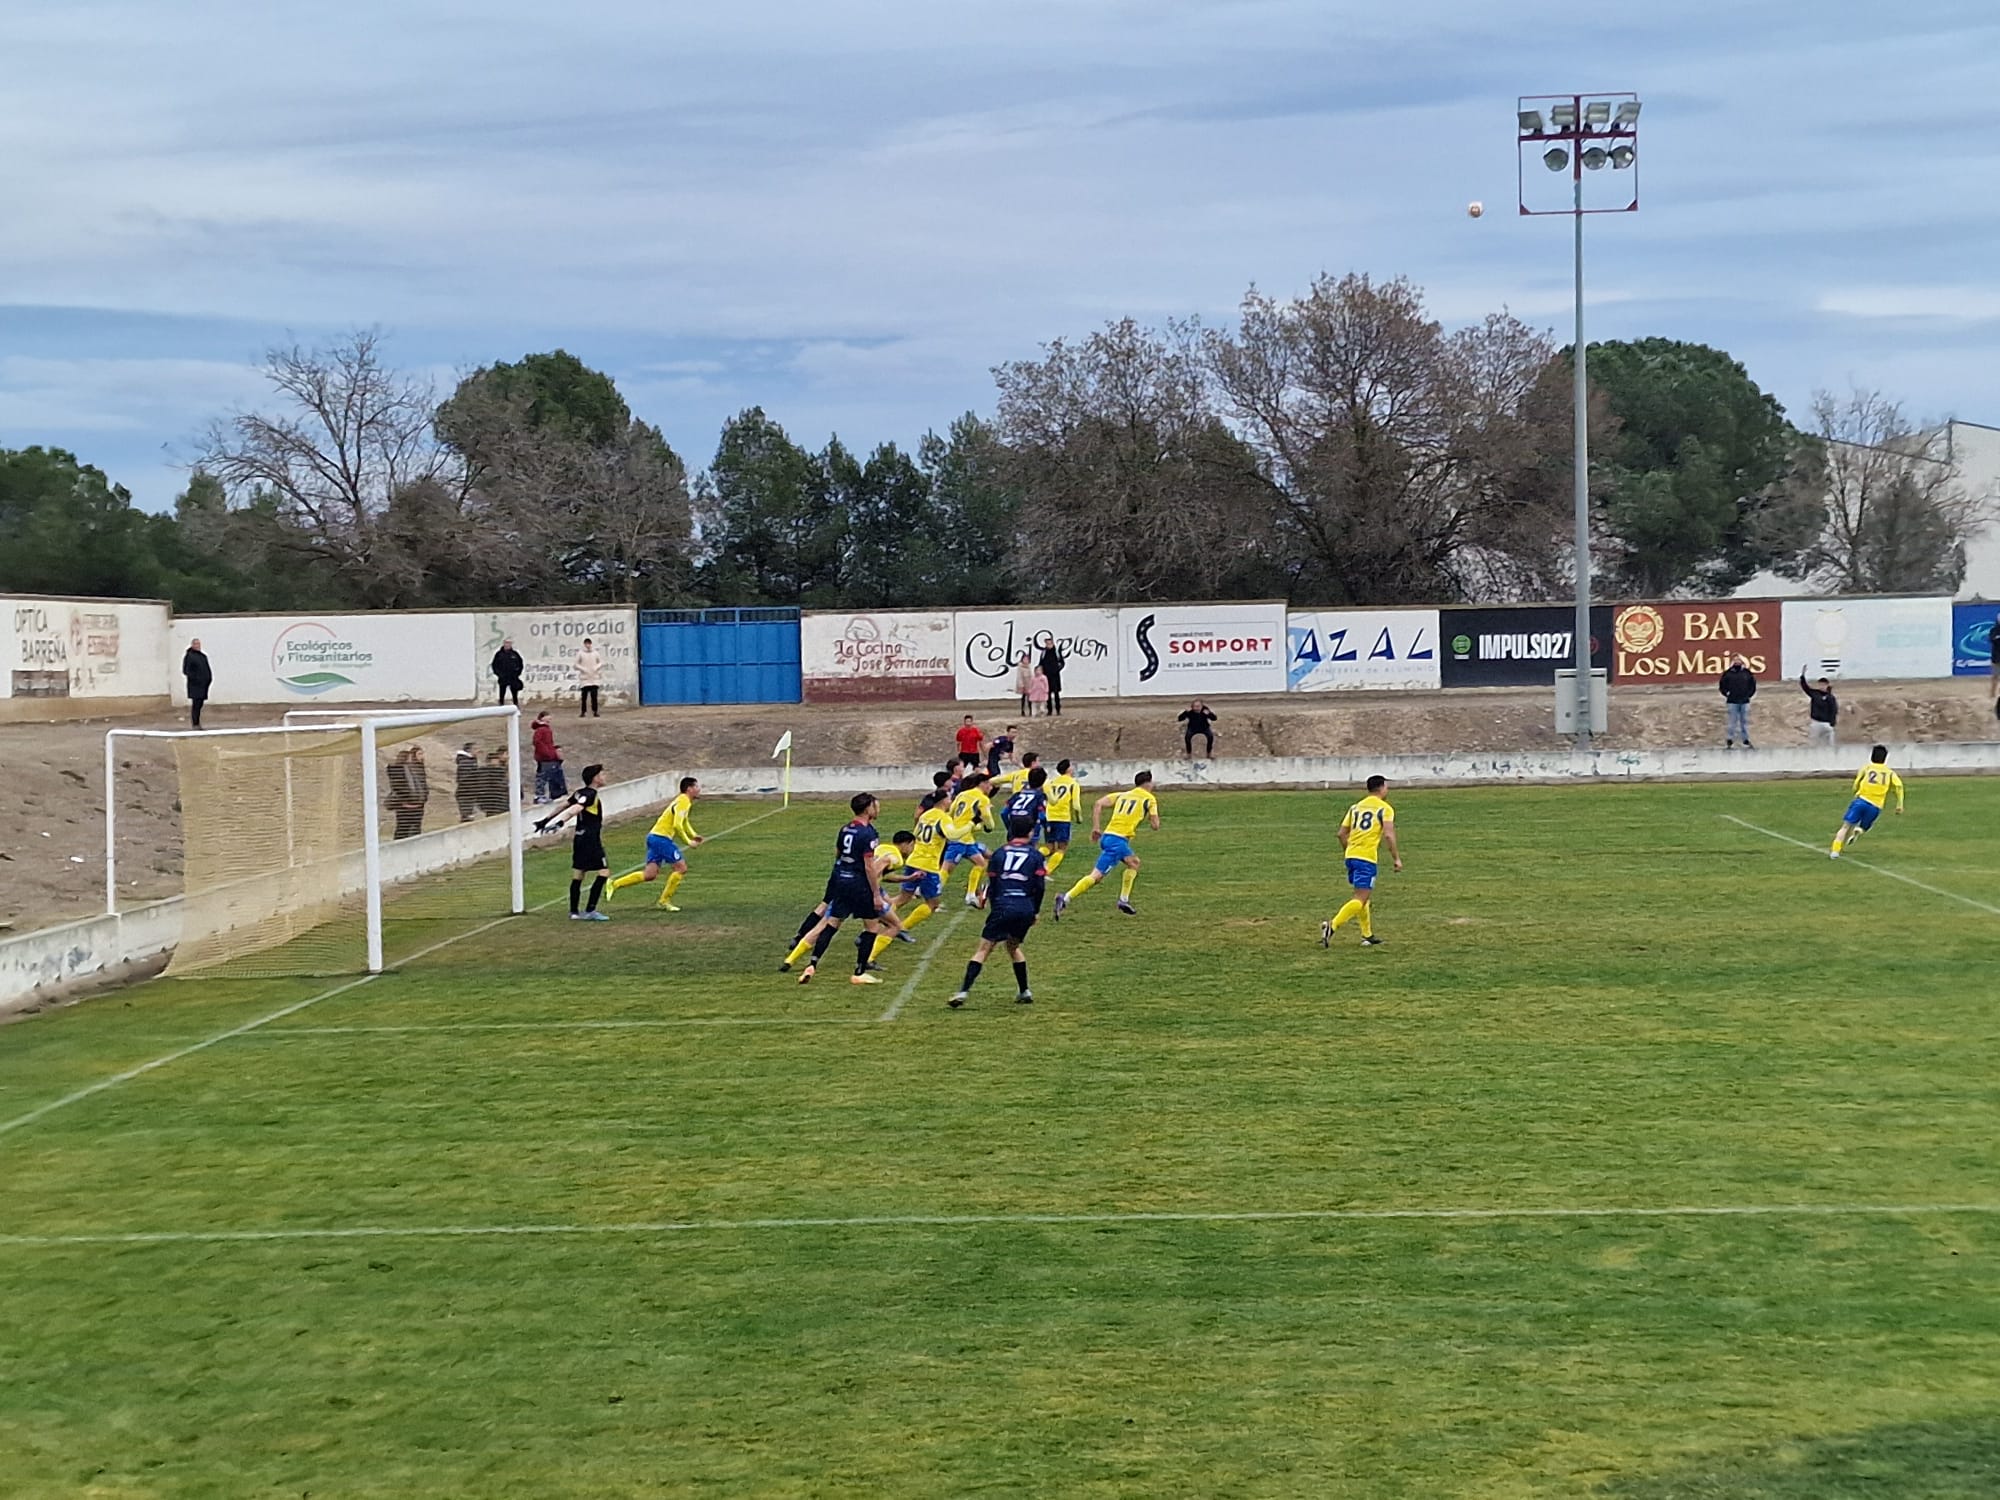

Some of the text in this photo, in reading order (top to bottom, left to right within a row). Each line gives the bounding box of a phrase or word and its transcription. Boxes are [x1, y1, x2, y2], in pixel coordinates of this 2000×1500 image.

[530, 619, 625, 637] ortopedia
[1683, 611, 1762, 641] BAR
[286, 640, 353, 653] Ecológicos
[856, 640, 902, 656] Cocina
[1169, 638, 1273, 654] SOMPORT
[1293, 626, 1433, 663] AZAL
[1478, 633, 1572, 660] IMPULSO27
[277, 655, 285, 665] y
[1617, 651, 1670, 676] Los
[955, 801, 966, 817] 8
[1011, 793, 1035, 810] 27
[1352, 811, 1374, 830] 18
[842, 834, 854, 854] 9
[1003, 851, 1029, 871] 17
